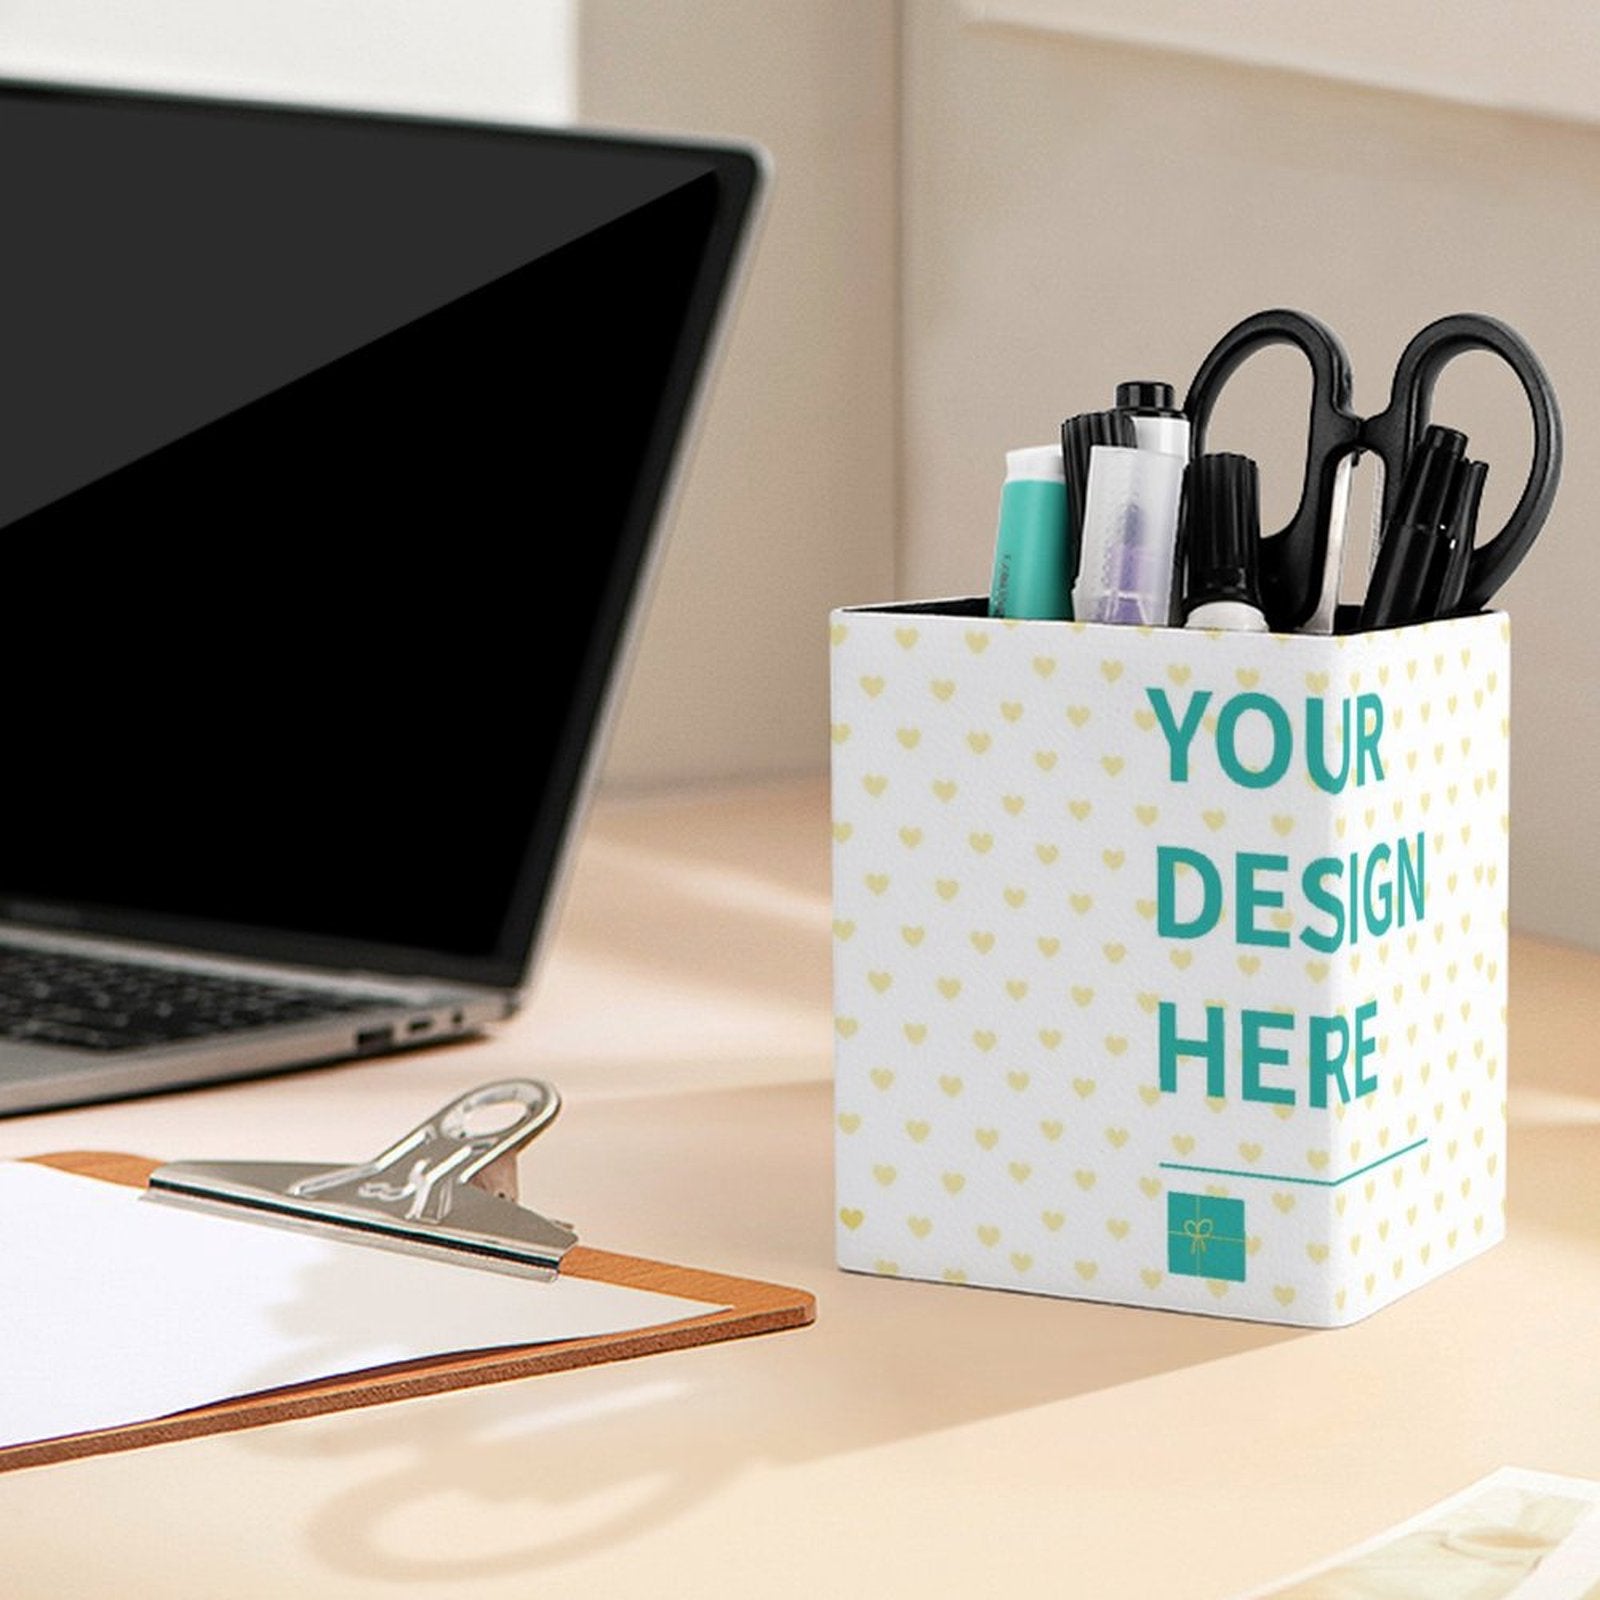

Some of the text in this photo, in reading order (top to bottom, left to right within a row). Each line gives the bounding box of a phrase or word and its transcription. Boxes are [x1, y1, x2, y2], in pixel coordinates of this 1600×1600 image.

[1147, 688, 1384, 795] YOUR
[1157, 832, 1425, 953] DESIGN
[1158, 1001, 1378, 1110] HERE
